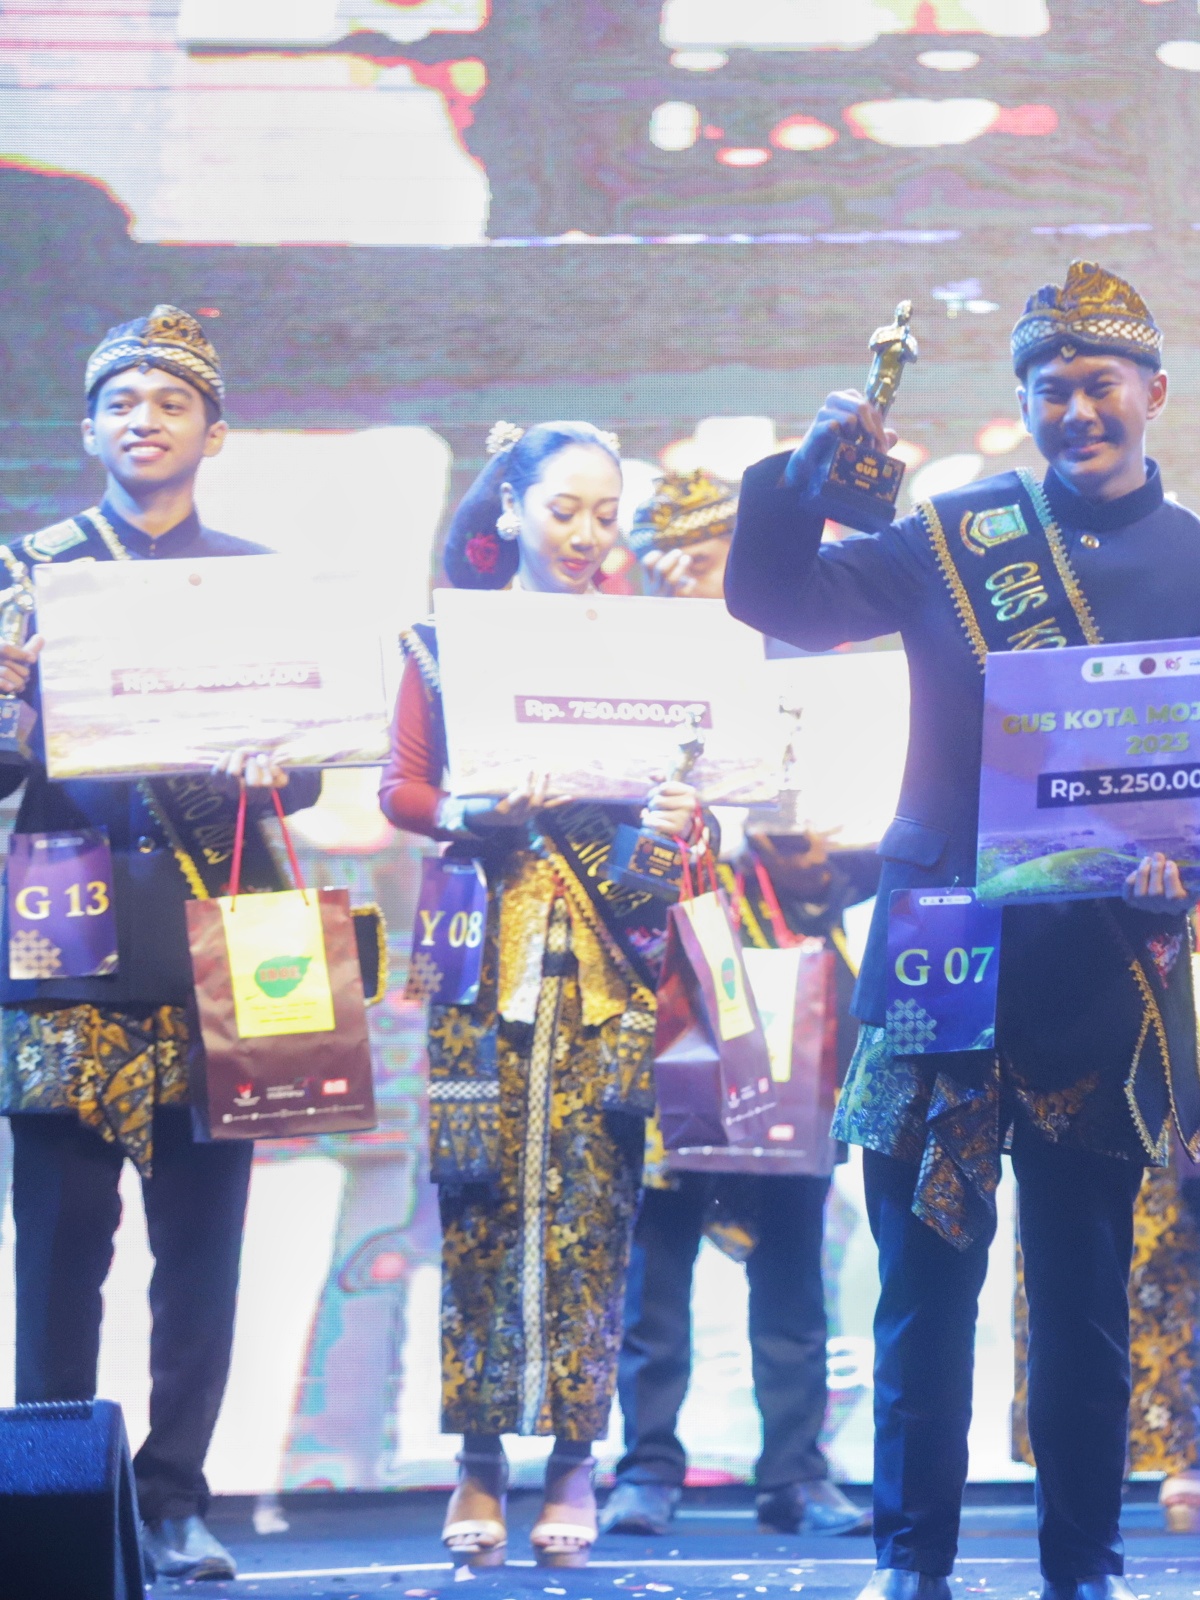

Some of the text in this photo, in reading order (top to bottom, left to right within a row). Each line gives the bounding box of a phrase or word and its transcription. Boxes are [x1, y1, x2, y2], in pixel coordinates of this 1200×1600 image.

[985, 561, 1048, 621] GUS
[1002, 712, 1056, 735] GUS
[1064, 706, 1139, 731] KOTA
[1126, 732, 1189, 755] 2023
[1051, 778, 1092, 801] Rp.
[15, 881, 110, 920] G 13
[419, 910, 483, 948] Y 08
[895, 946, 995, 986] G 07
